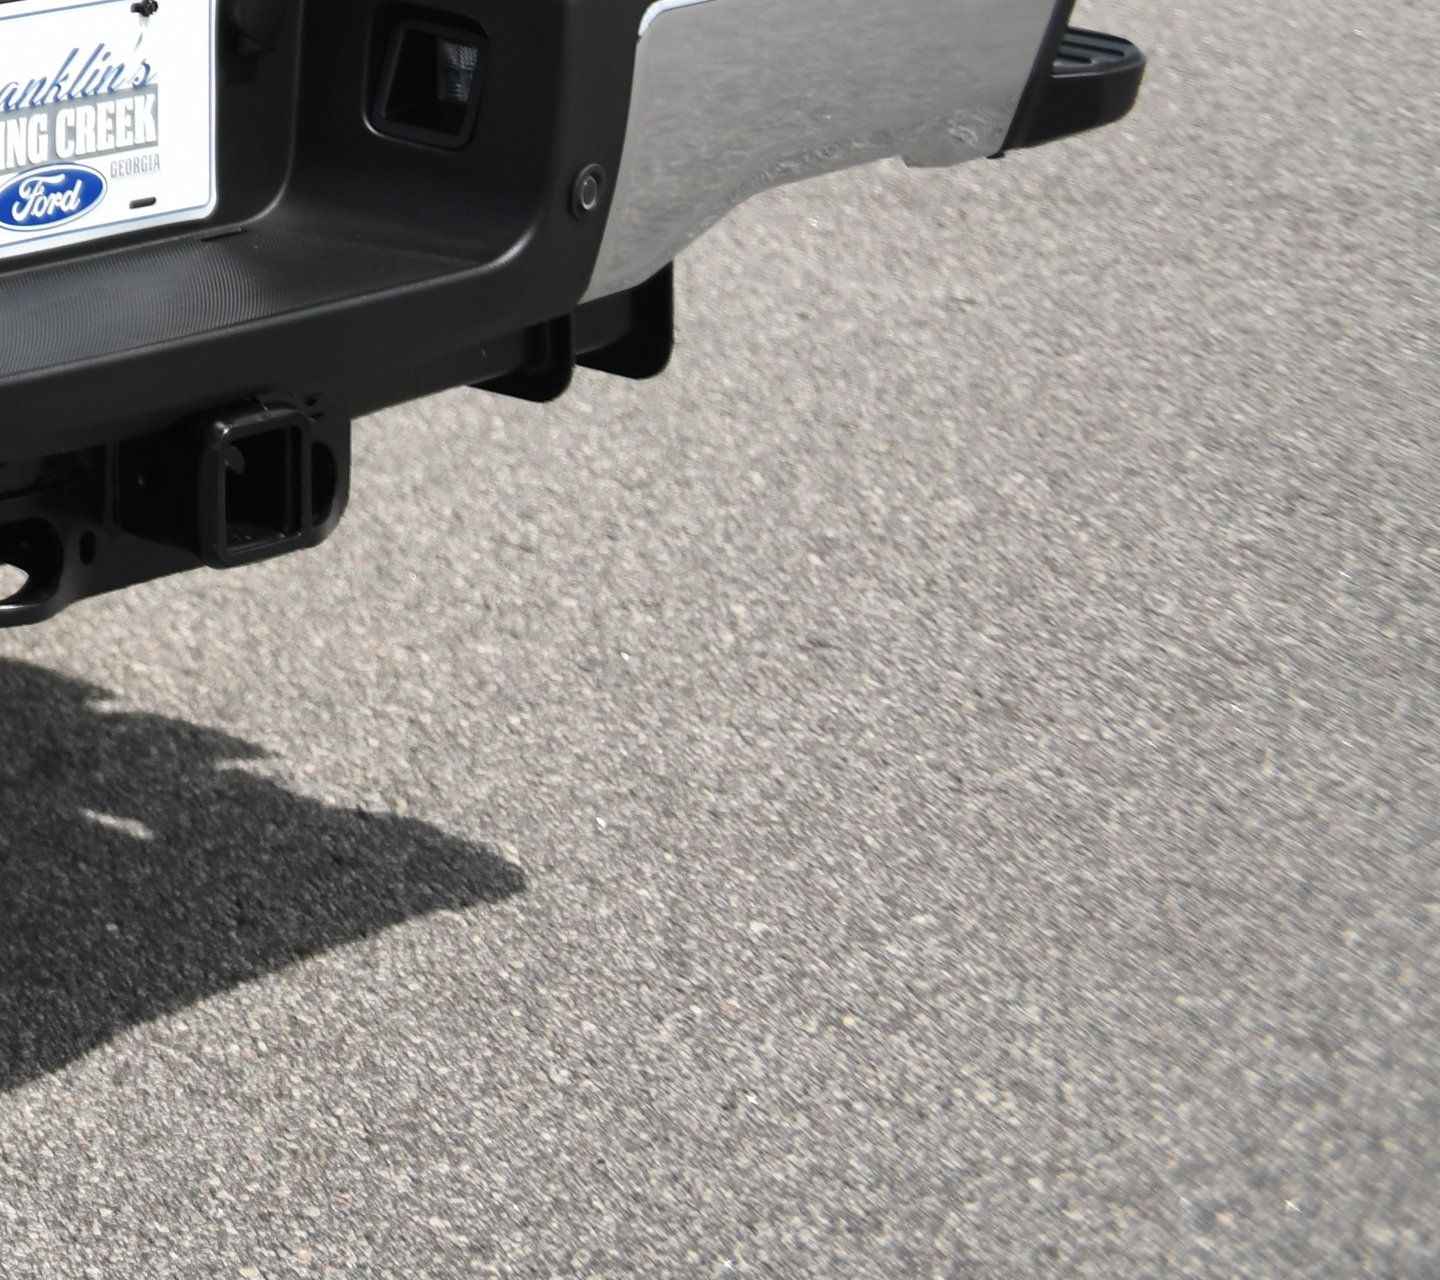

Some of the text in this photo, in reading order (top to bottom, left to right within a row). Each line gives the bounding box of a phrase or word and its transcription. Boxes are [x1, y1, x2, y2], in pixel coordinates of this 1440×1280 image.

[54, 93, 157, 159] CREEK
[109, 153, 161, 179] GEORGIA
[11, 173, 83, 222] Ford
